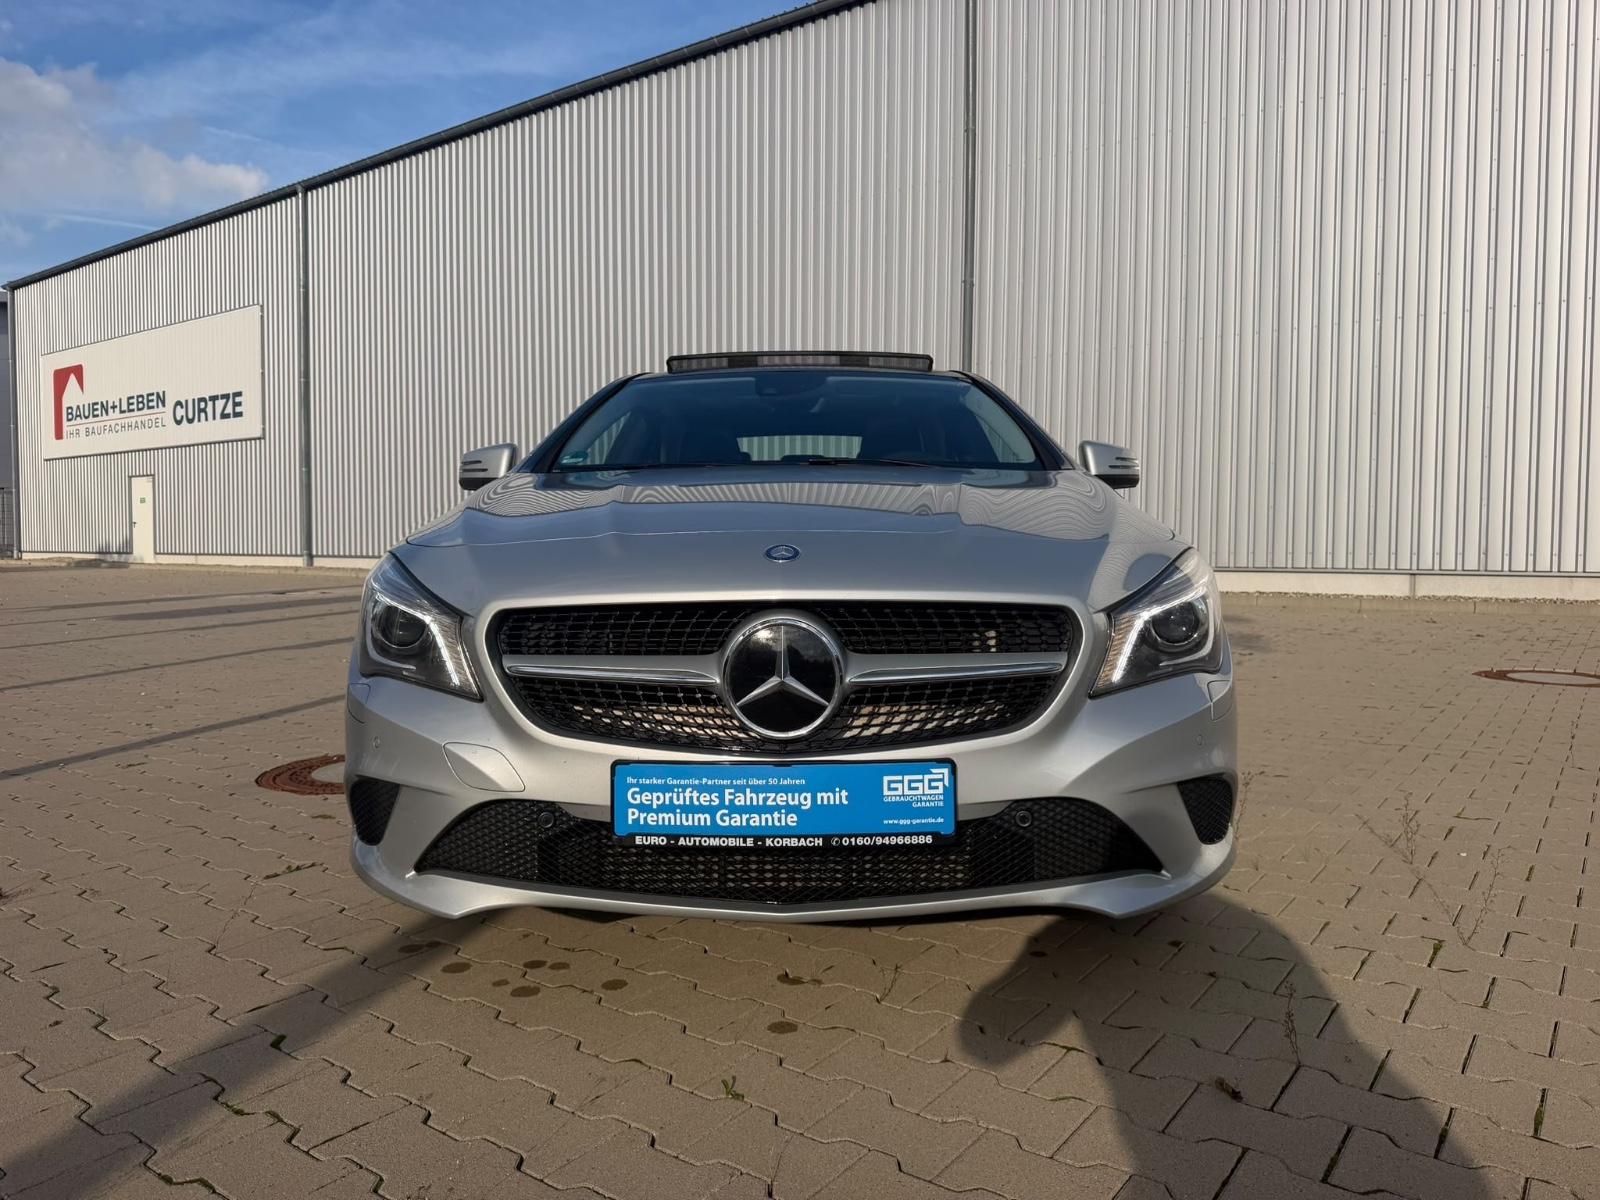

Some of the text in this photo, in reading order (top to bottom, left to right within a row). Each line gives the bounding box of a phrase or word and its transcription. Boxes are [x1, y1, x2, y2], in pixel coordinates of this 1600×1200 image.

[66, 390, 166, 422] BAUEN+LEBEN
[172, 390, 243, 426] CURTZE
[66, 416, 166, 439] IHR BAUFACHHANDEL
[639, 777, 665, 785] starker
[667, 777, 731, 785] Garantie-Partner
[883, 774, 944, 796] GGG
[627, 787, 849, 810] Geprüftes Fahrzeug mit
[627, 808, 798, 826] Premium Garantie
[883, 817, 944, 825] www.ggg-garantie.de
[634, 836, 667, 845] EURO
[677, 837, 754, 847] AUTOMOBILE
[765, 837, 823, 847] KORBACH
[842, 835, 933, 846] 0160/94966886
